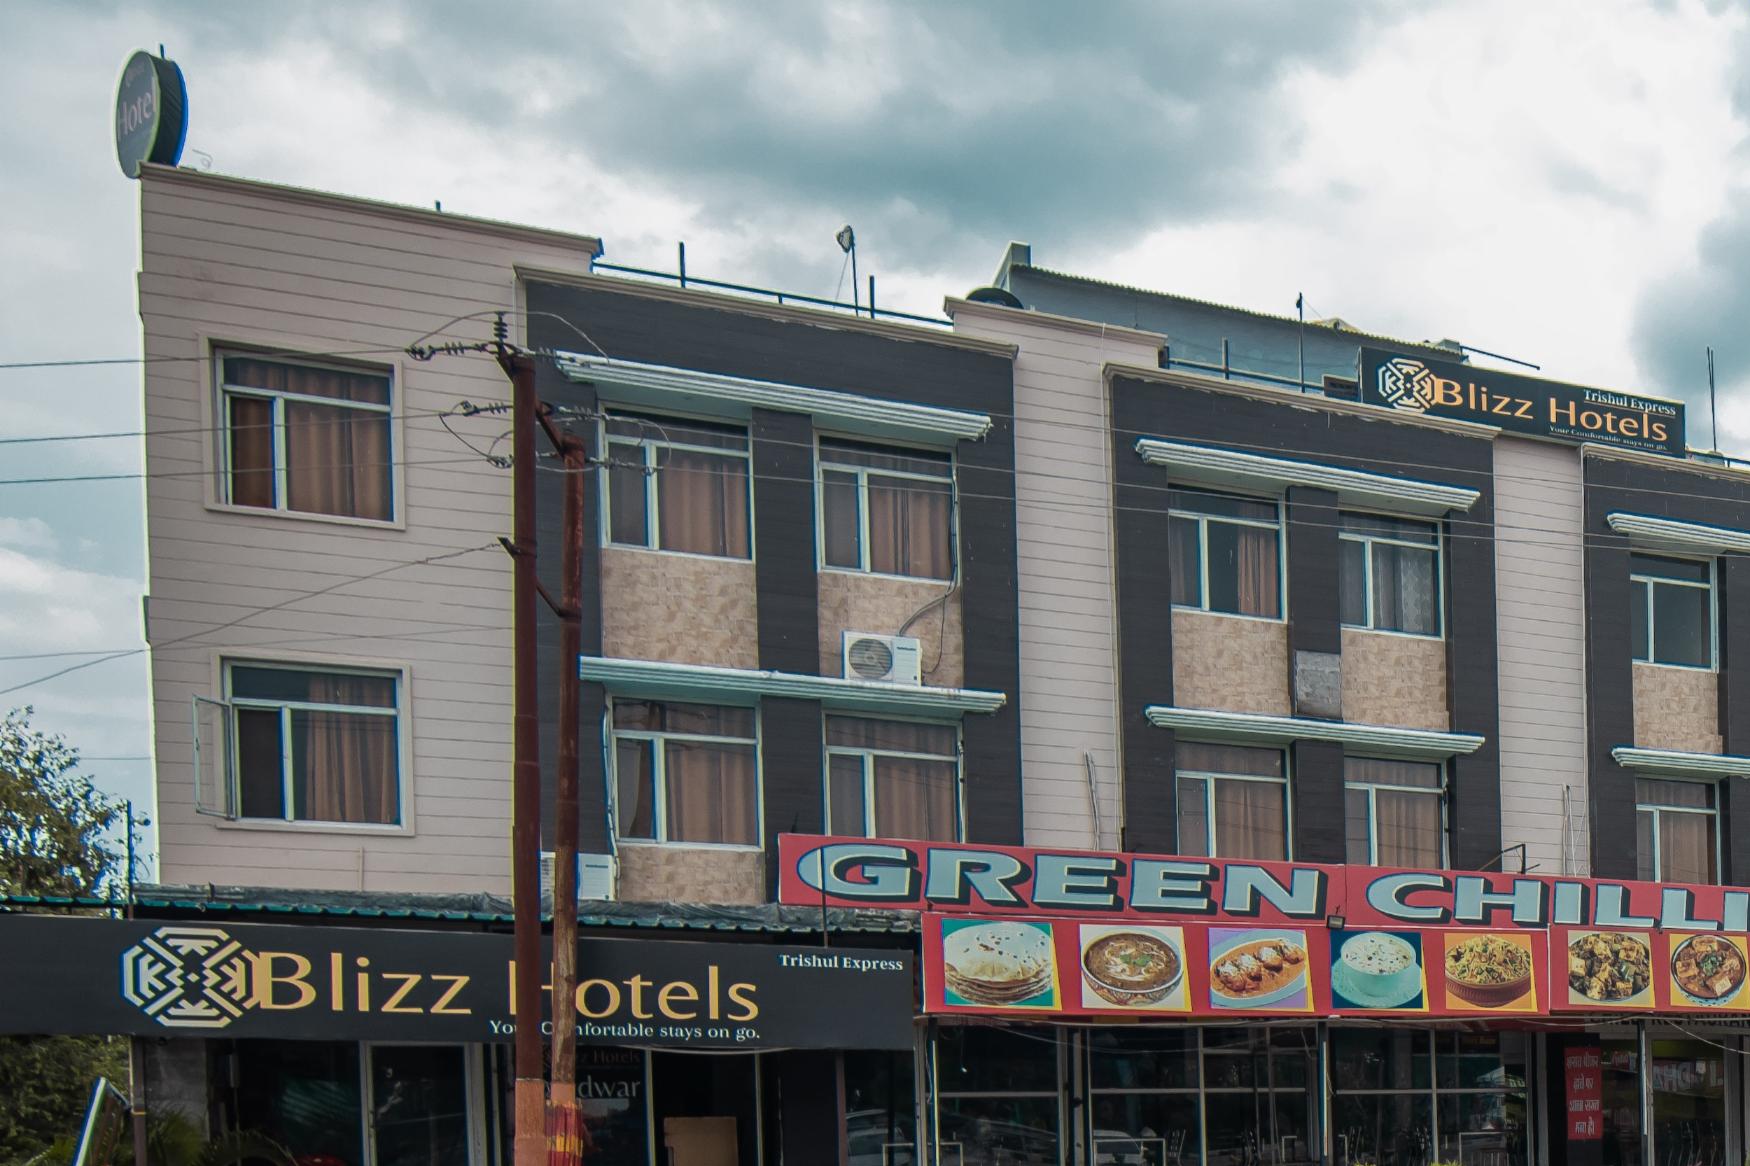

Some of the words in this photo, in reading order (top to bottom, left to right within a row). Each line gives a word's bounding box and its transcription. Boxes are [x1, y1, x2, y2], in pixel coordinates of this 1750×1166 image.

[117, 78, 157, 140] Hotel
[1437, 378, 1534, 420] Blizz
[1550, 398, 1667, 441] Hotels
[1584, 389, 1629, 407] Trishul
[1630, 397, 1676, 415] Express
[797, 843, 1325, 916] GREEN
[252, 951, 472, 1014] Blizz
[780, 954, 839, 968] Trishul
[843, 957, 903, 972] Express
[490, 1020, 517, 1035] Yo
[541, 1021, 654, 1037] Cmfortable
[660, 1025, 702, 1040] stays
[708, 1028, 729, 1038] on
[736, 1028, 760, 1041] go.
